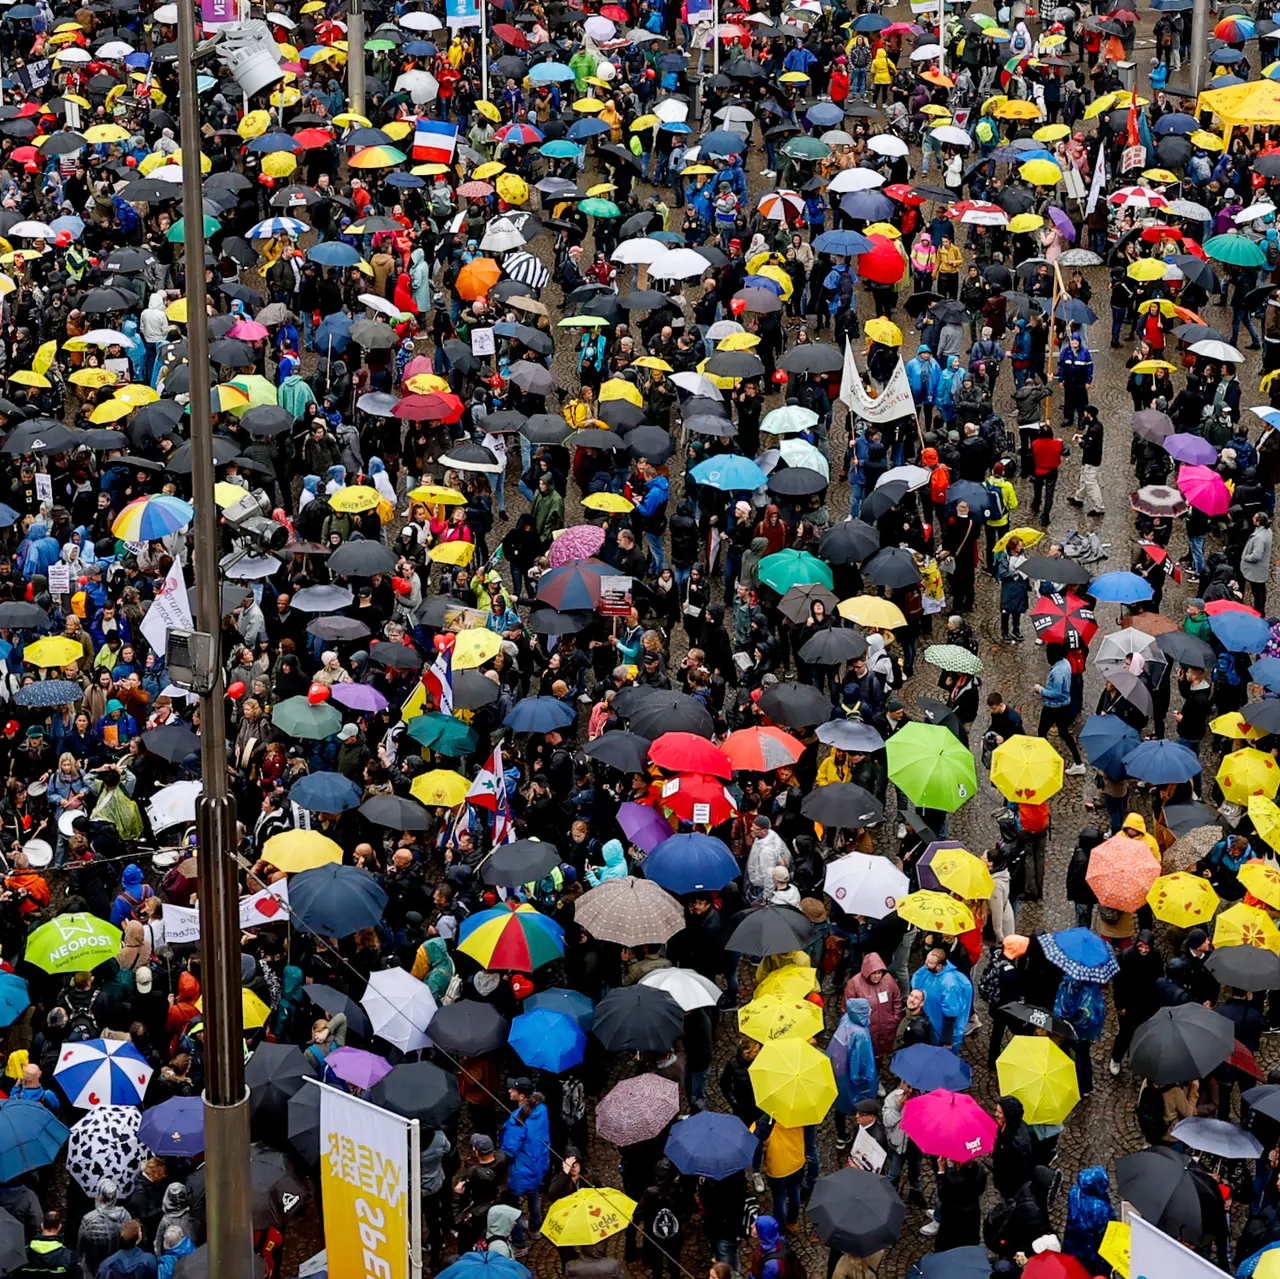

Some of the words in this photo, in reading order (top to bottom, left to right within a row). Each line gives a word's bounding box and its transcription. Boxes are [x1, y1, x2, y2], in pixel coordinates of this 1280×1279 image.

[340, 500, 358, 510] NEVER
[49, 933, 114, 964] NEOPOST
[55, 959, 72, 969] Send
[72, 954, 93, 964] Receive
[93, 948, 114, 958] Connect
[590, 1212, 618, 1234] Liefde
